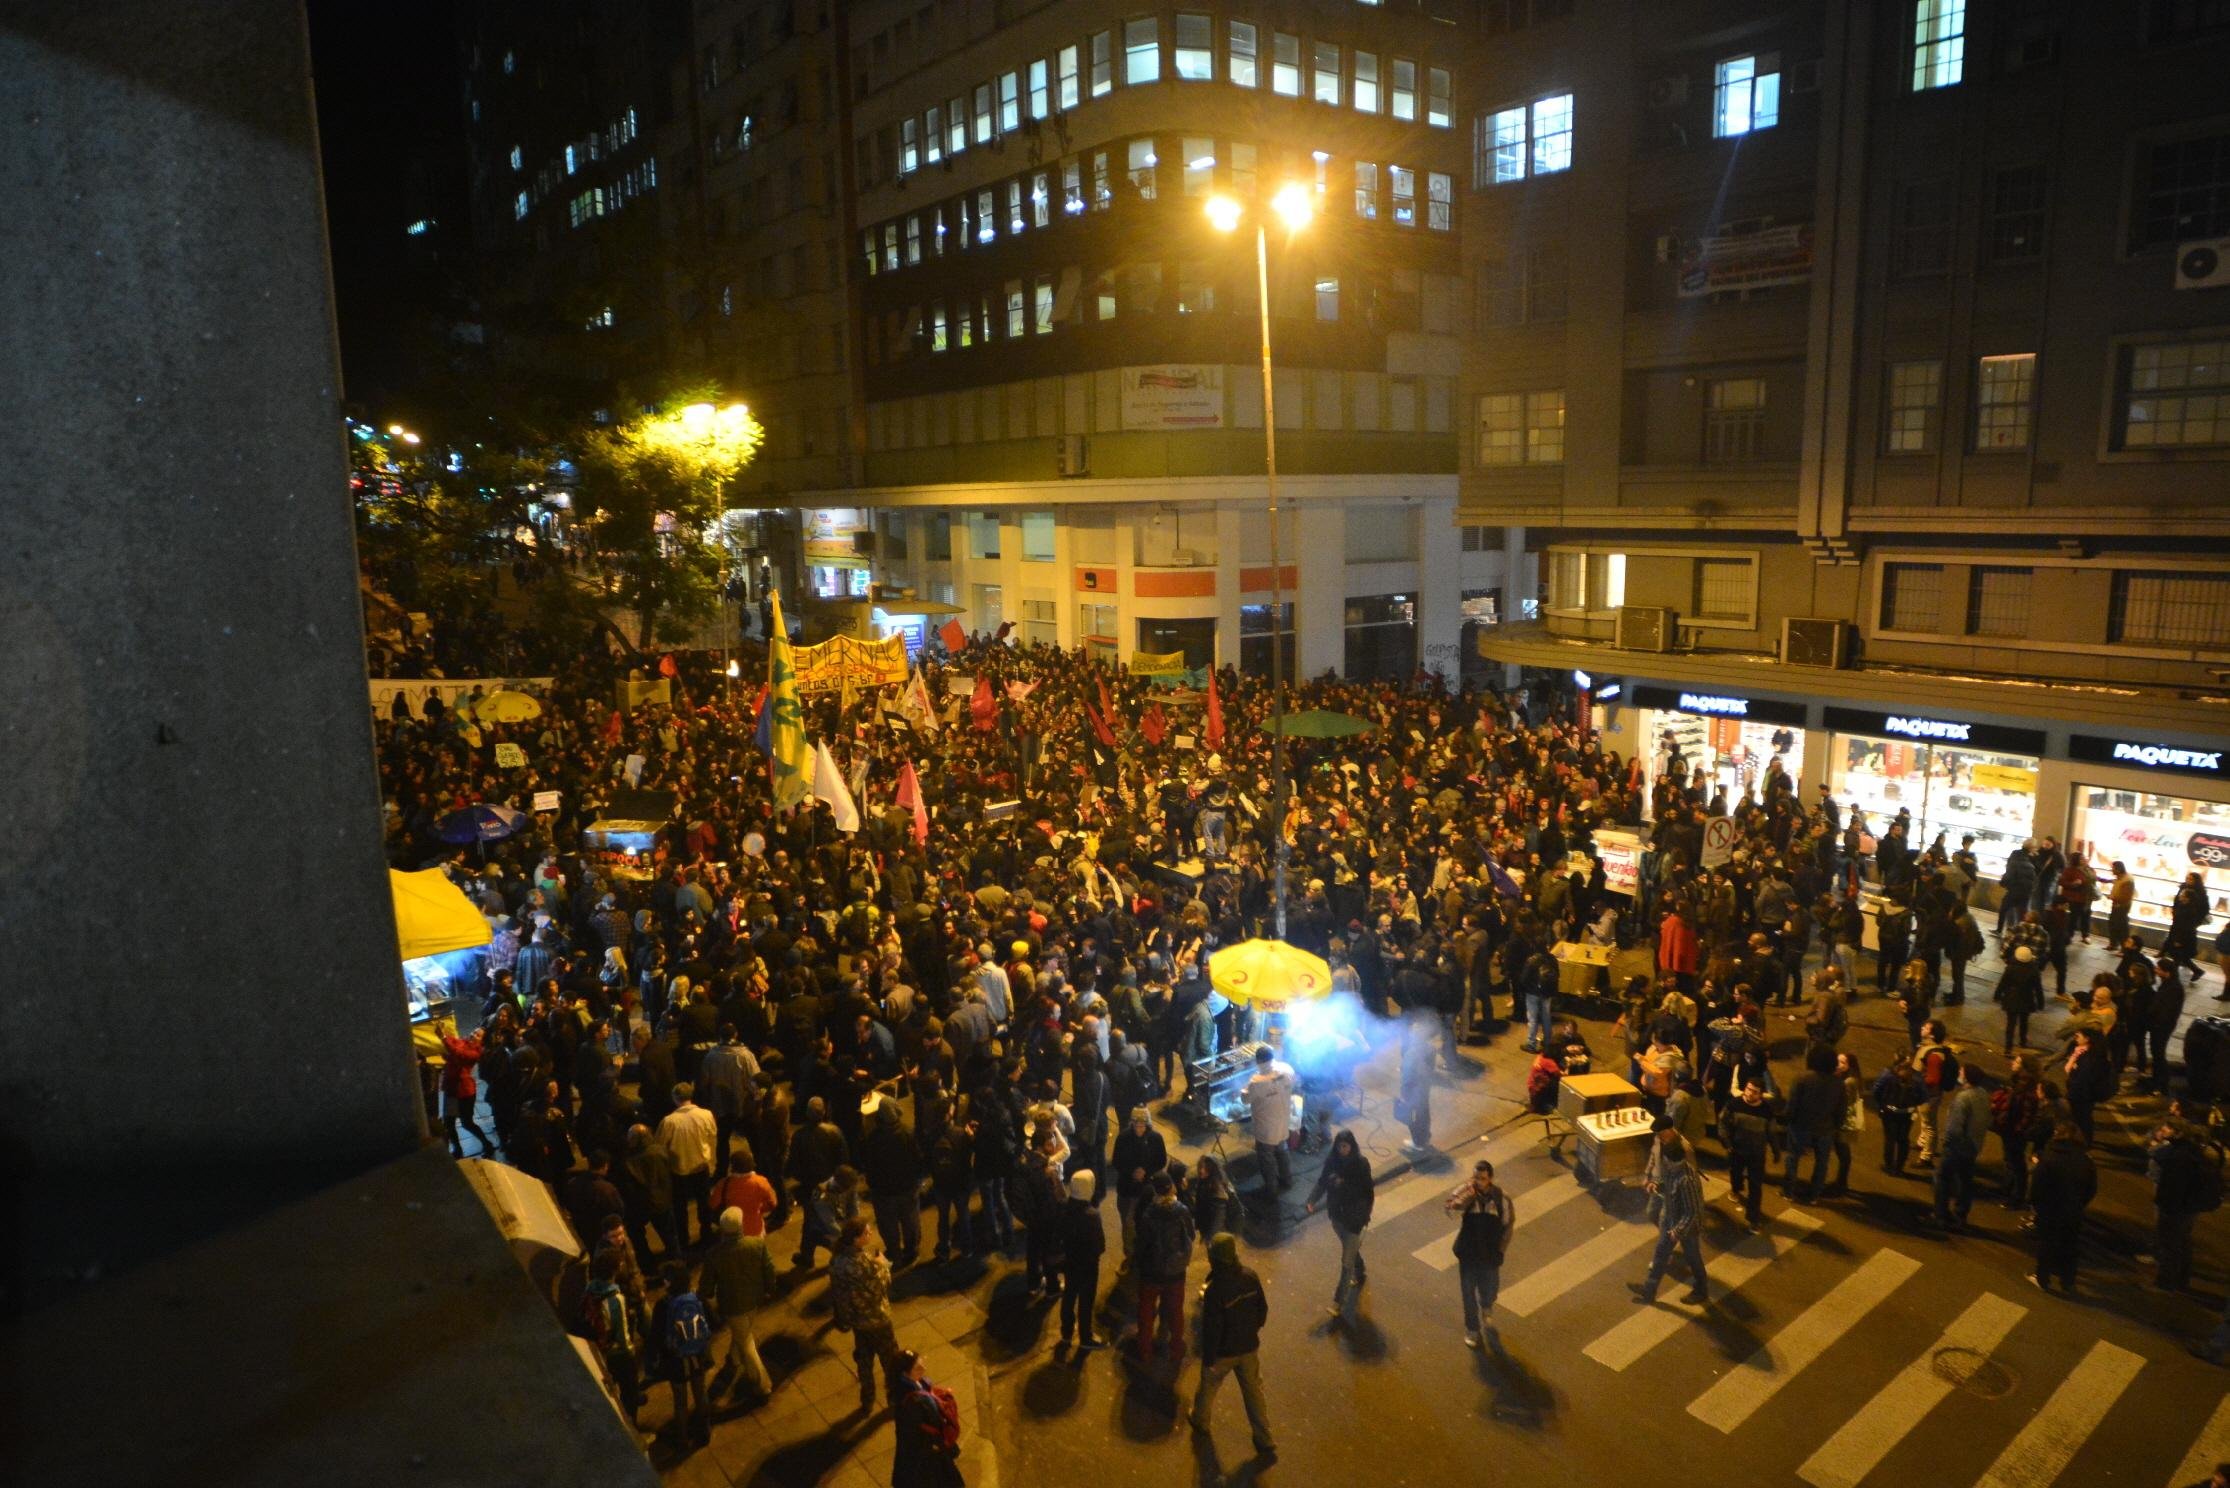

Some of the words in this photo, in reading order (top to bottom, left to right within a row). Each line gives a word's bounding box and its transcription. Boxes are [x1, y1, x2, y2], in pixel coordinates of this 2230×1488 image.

[1679, 691, 1749, 714] PAQUETÁ
[1885, 716, 1972, 740] PAQUETÁ
[2113, 743, 2222, 769] PAQUETÁ
